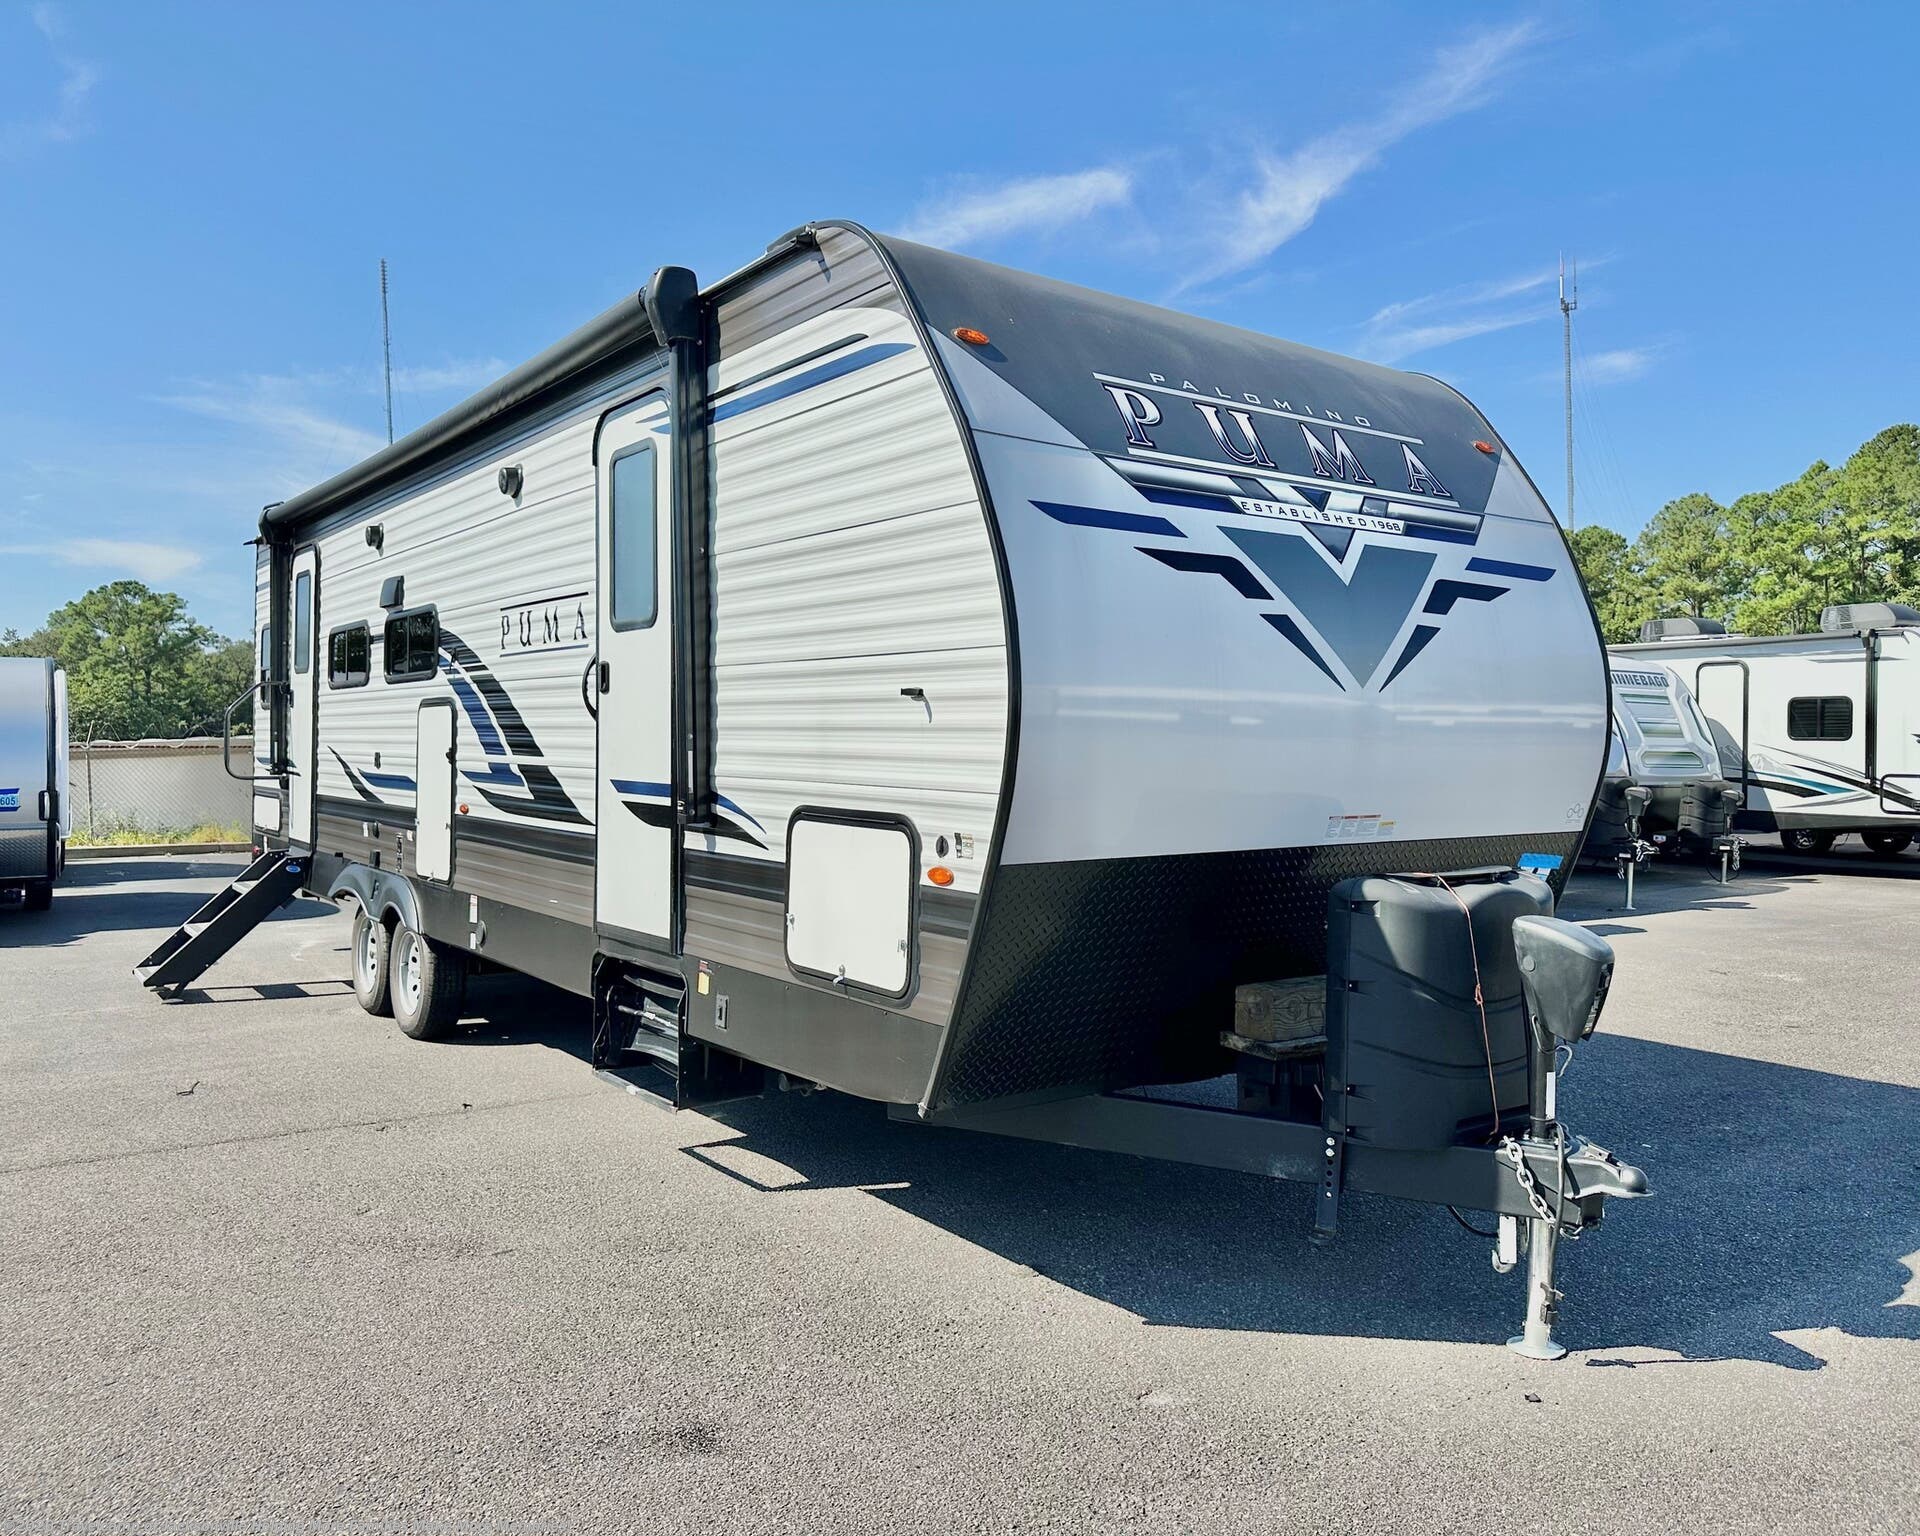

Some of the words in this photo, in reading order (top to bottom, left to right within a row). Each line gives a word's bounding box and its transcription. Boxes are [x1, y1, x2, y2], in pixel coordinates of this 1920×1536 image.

[1149, 372, 1371, 427] PALOMINO
[1104, 383, 1452, 497] PUMA
[1240, 501, 1368, 527] ESTABLISHED
[1371, 519, 1401, 532] 1968
[500, 601, 588, 650] PUMA
[1611, 673, 1669, 688] INNEBAGO
